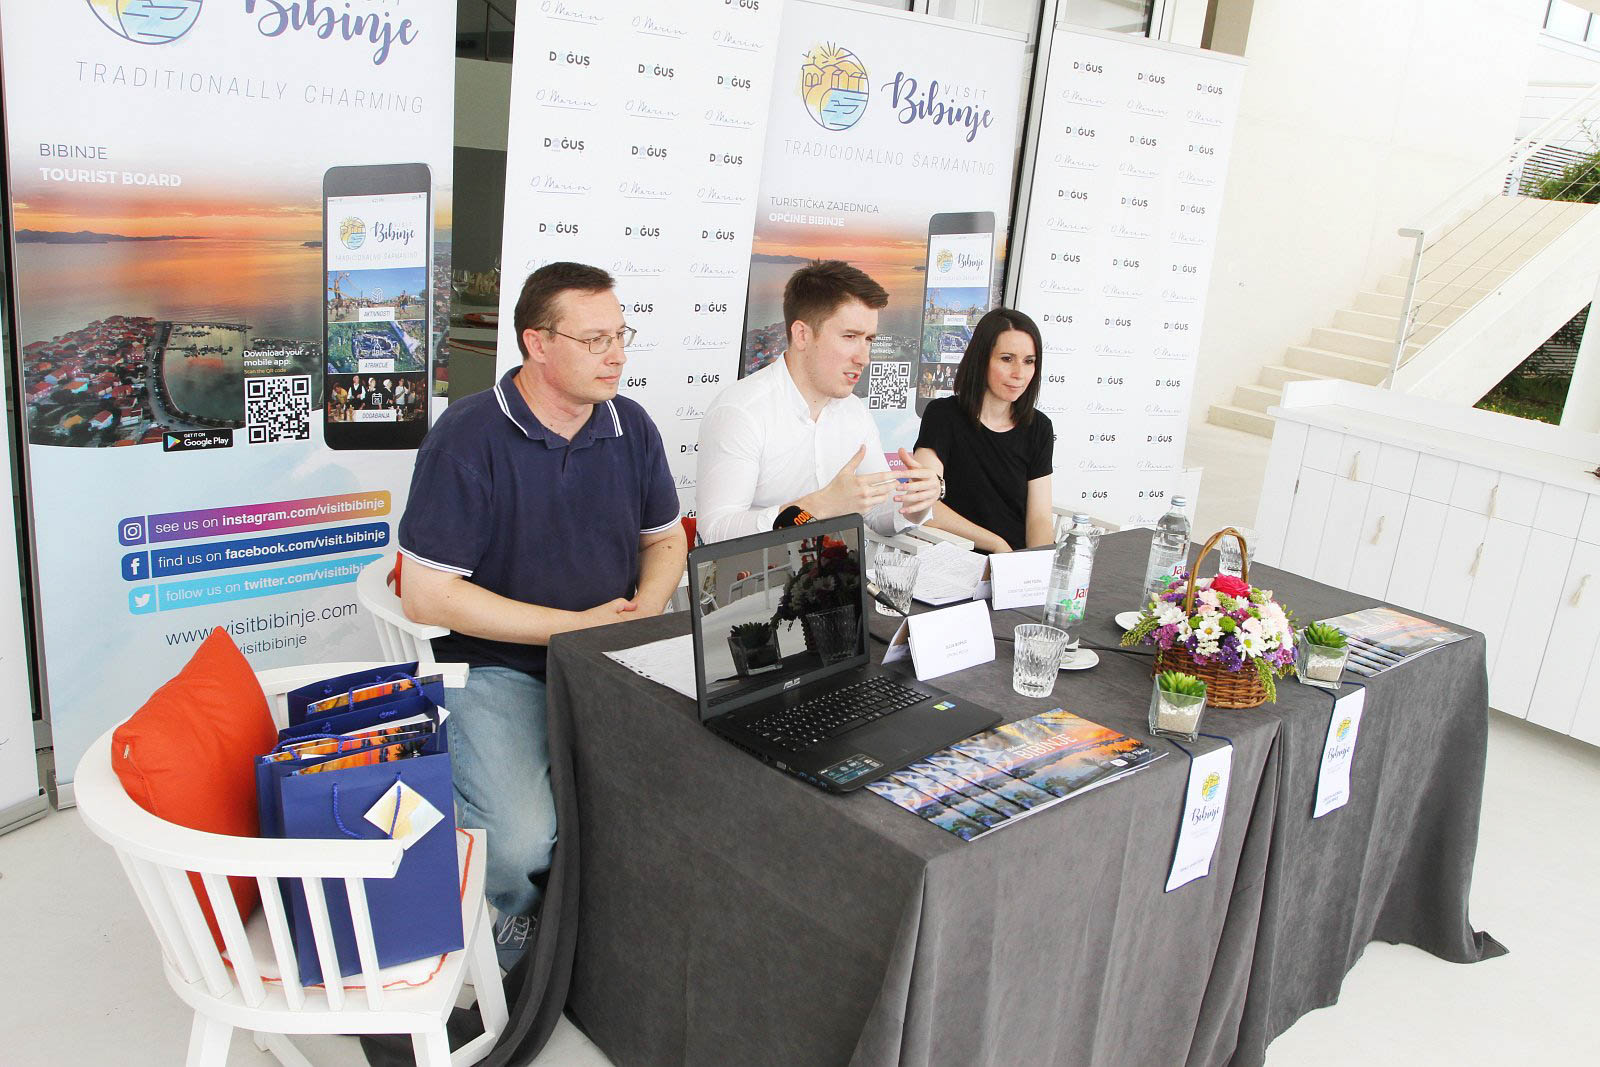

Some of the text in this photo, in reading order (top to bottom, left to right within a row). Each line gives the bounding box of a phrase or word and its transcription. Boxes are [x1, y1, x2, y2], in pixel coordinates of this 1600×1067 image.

[76, 61, 424, 114] TRADITIONALLY CHARMING
[945, 84, 987, 98] VISIT
[881, 71, 994, 143] Bibinje
[39, 143, 108, 160] BIBINJE
[784, 139, 996, 176] TRADICIONALNO ŠARMANTNO
[39, 167, 182, 187] TOURIST BOARD
[770, 196, 879, 214] TURISTIČKA ZAJEDNICA
[808, 216, 845, 227] BIBINJE
[244, 349, 304, 358] Download your
[184, 437, 229, 447] Google Play
[155, 497, 385, 534] see us on instagram.com/visitbibinje
[158, 529, 386, 568] find us on facebook.com/visit.bibinje
[166, 563, 364, 602] follow us on twitter.com/visitbibi
[1013, 733, 1078, 760] BIBINJE
